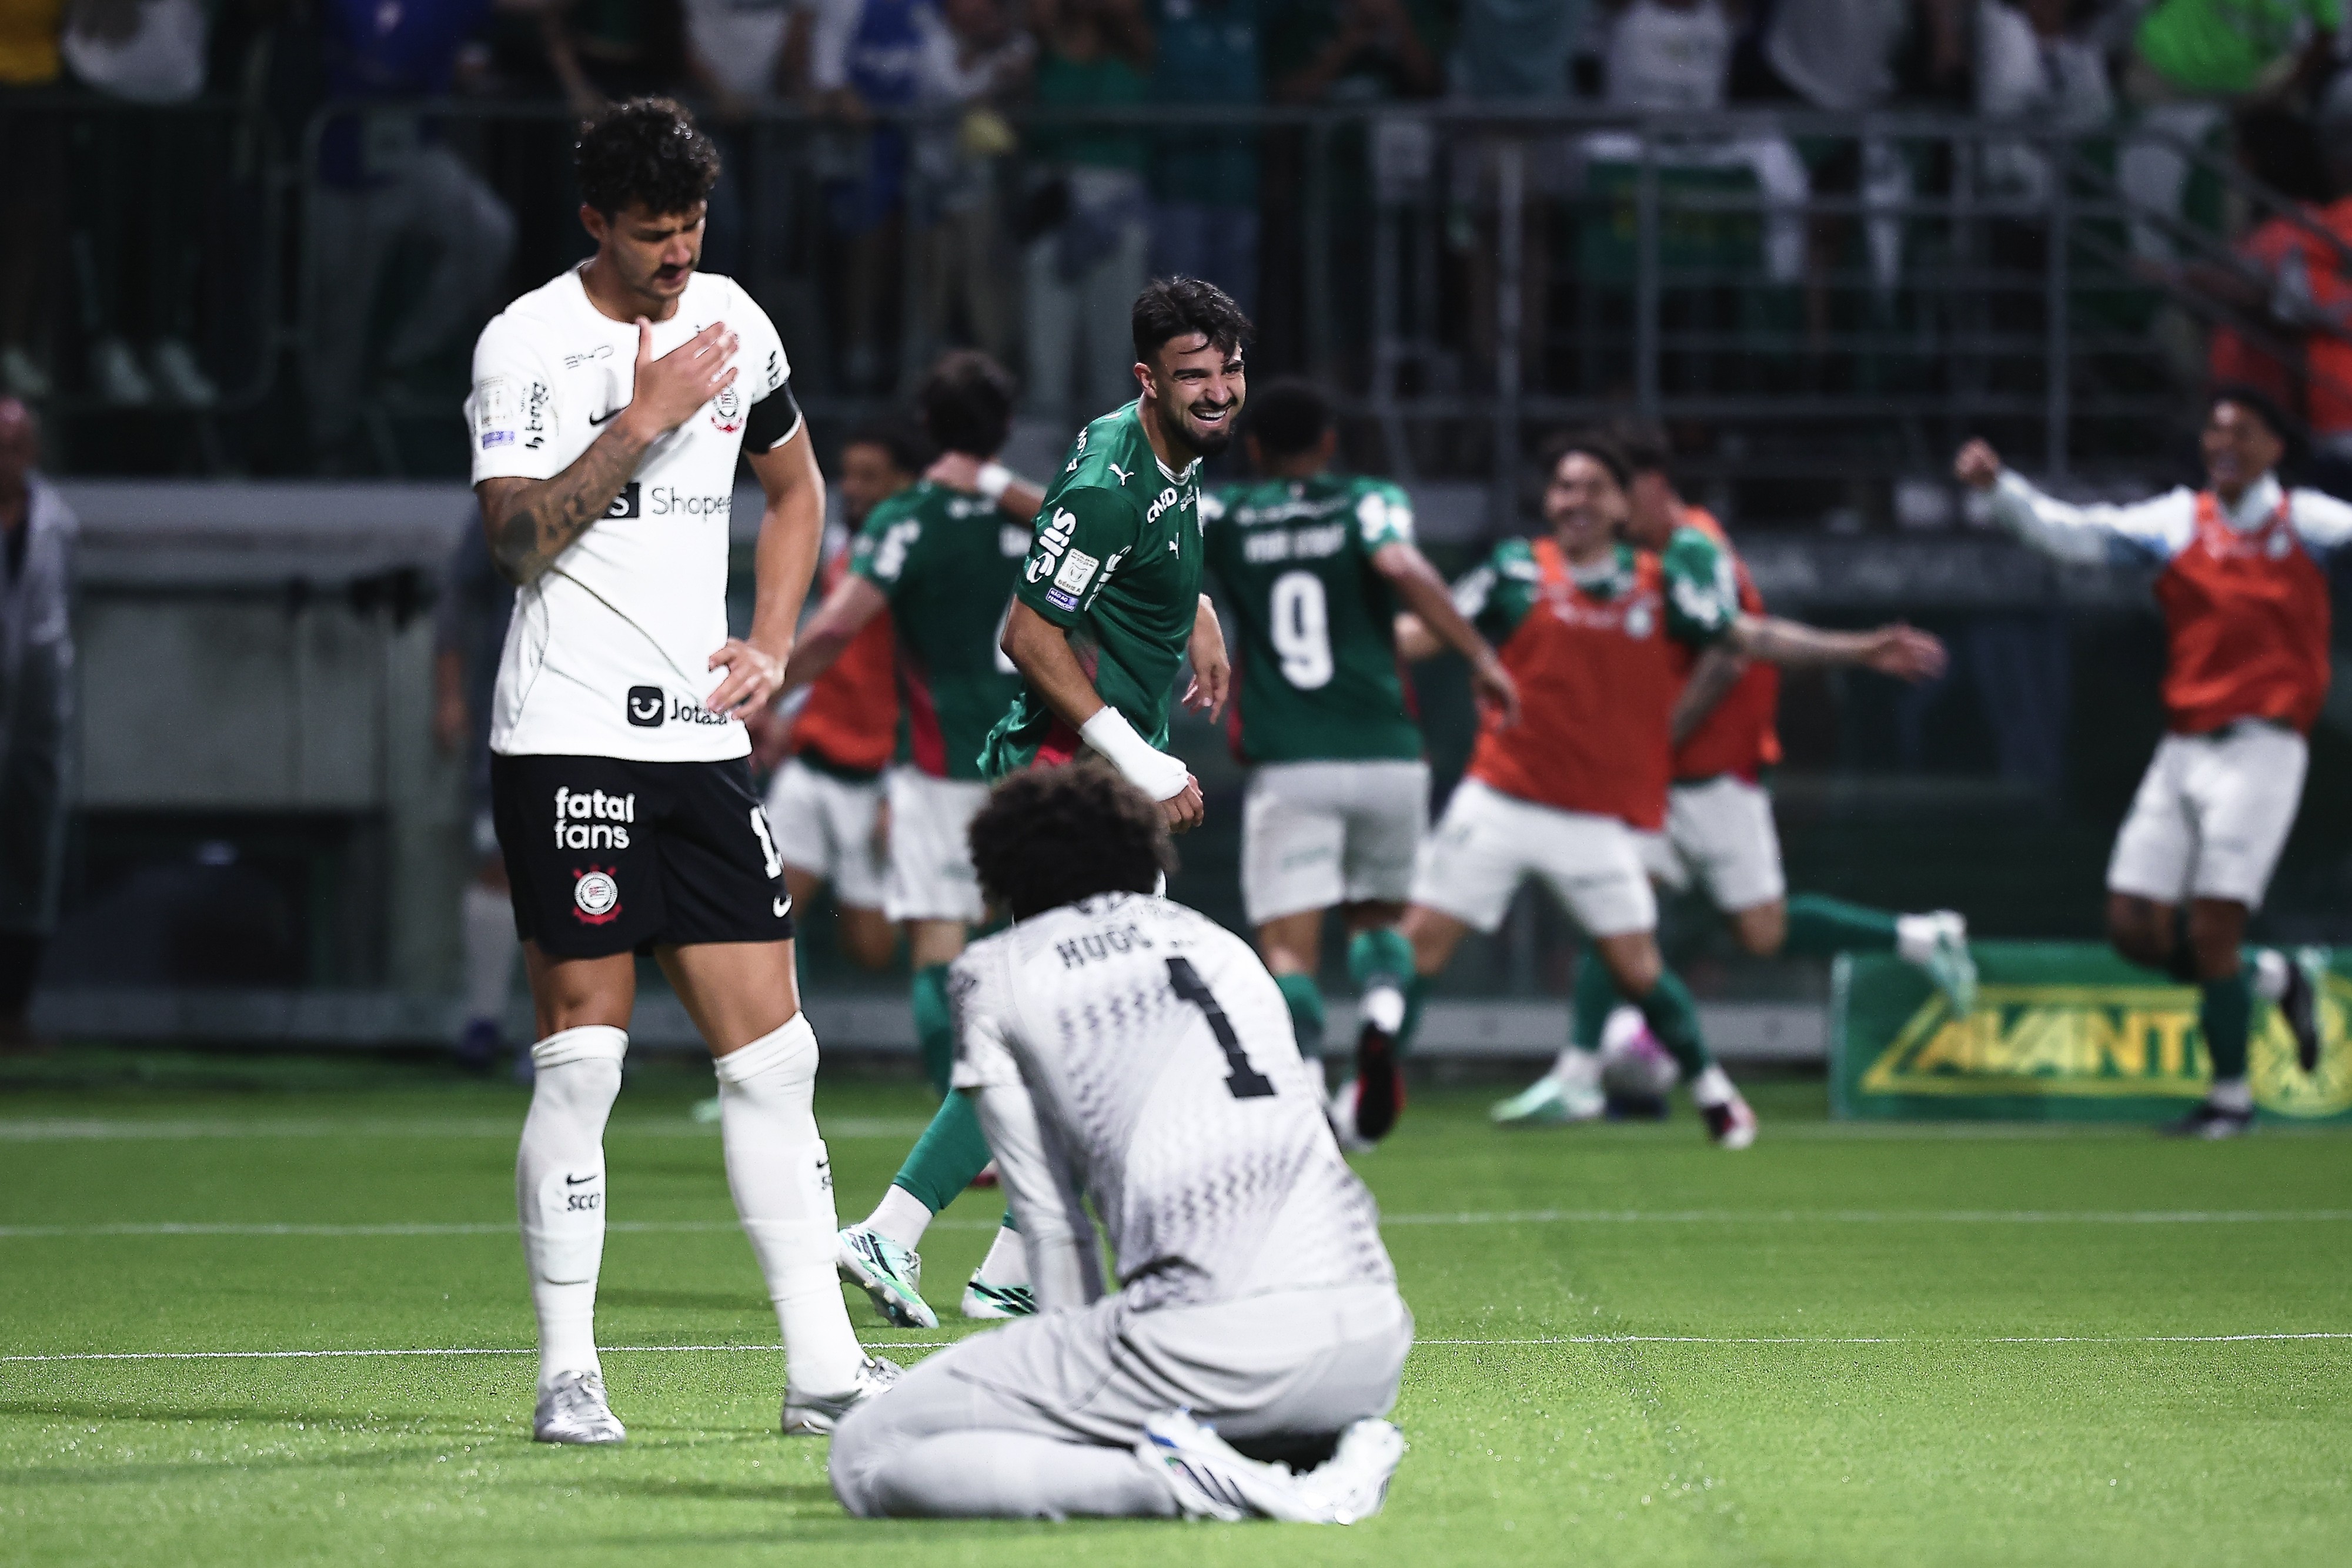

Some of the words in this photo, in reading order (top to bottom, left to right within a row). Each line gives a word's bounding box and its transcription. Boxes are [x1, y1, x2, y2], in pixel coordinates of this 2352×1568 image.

[1271, 570, 1335, 690] 9
[554, 786, 635, 823] fatal
[554, 818, 630, 849] fans
[1165, 957, 1277, 1098] 1
